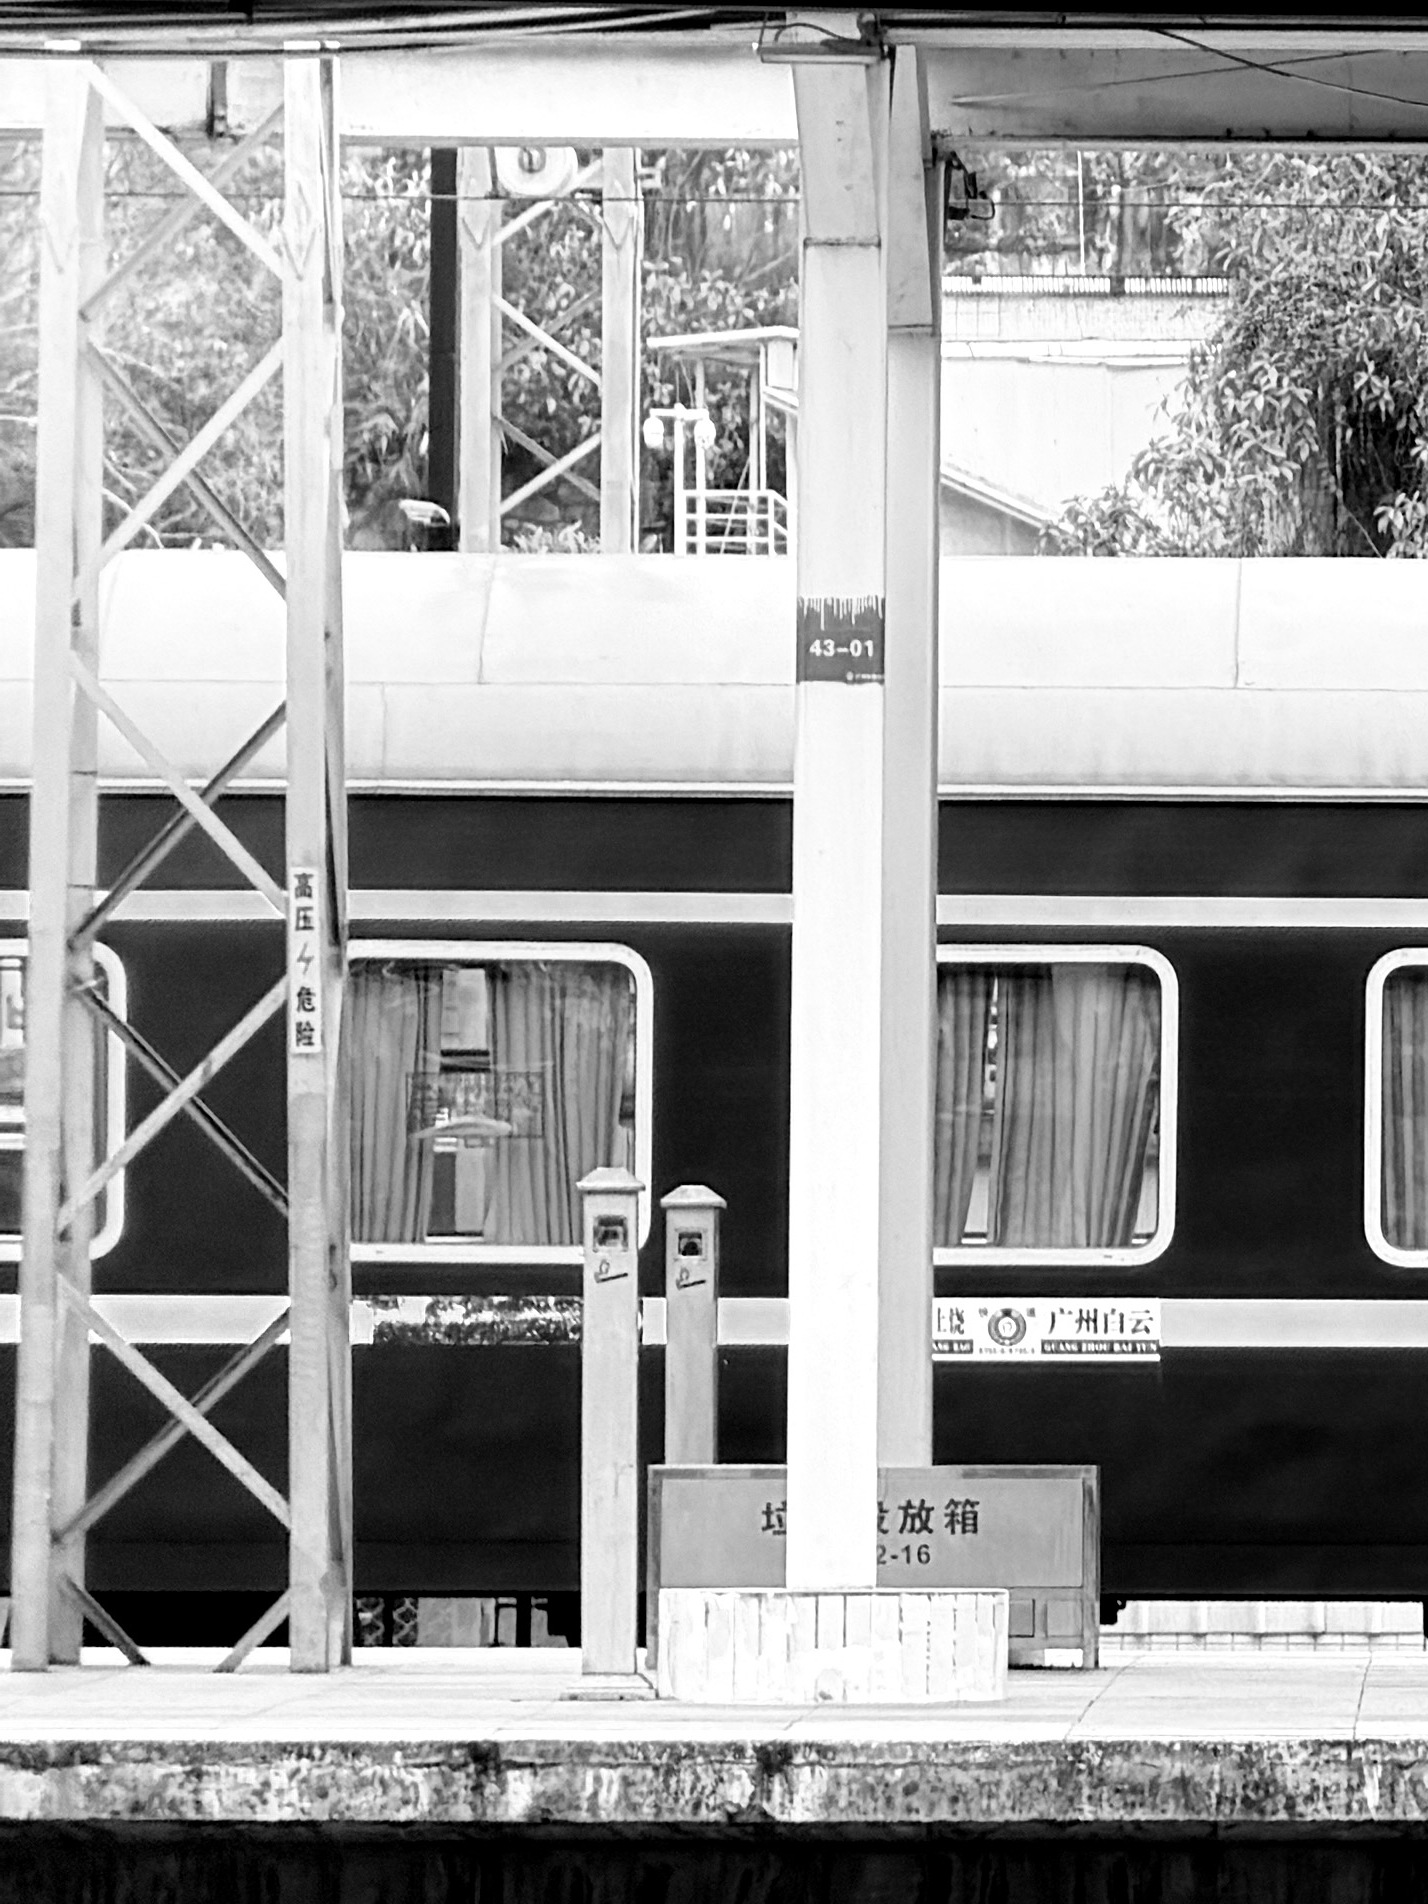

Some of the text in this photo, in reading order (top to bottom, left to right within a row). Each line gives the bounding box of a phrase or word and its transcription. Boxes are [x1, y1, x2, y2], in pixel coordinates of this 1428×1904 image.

[809, 638, 874, 657] 43-01
[1048, 1306, 1154, 1335] 广州白云
